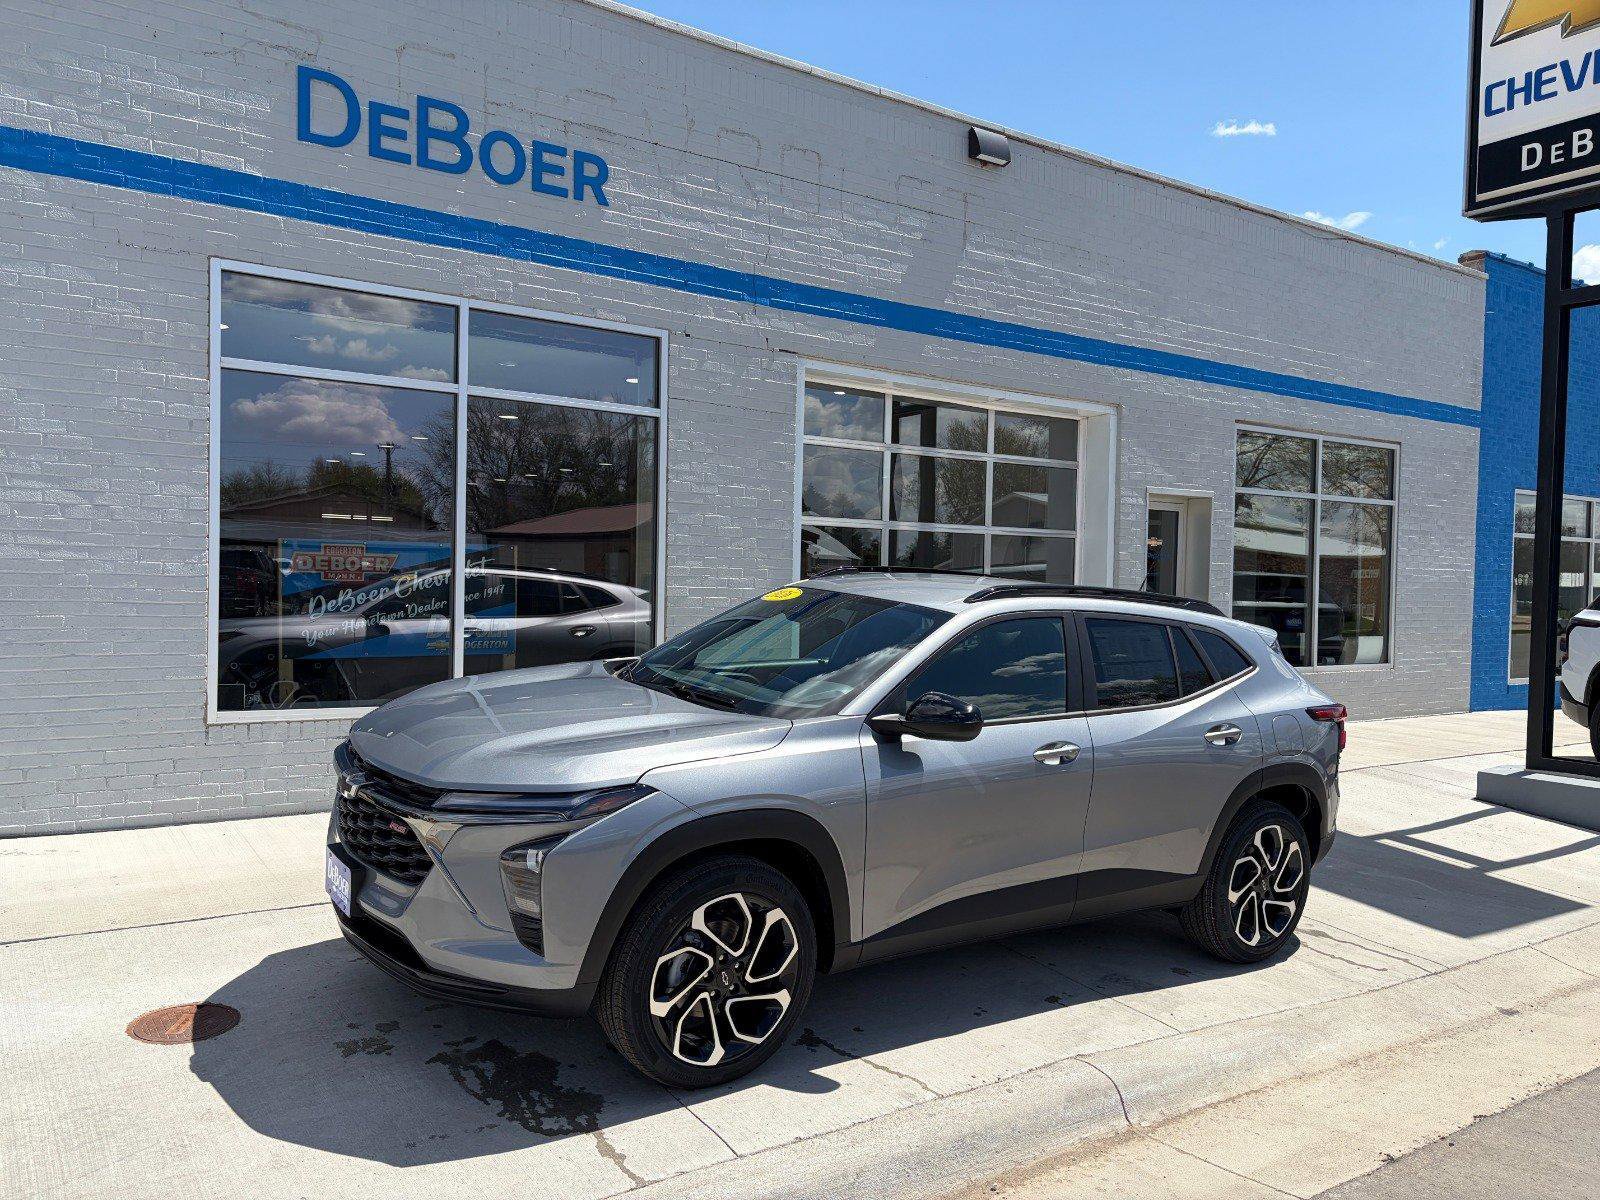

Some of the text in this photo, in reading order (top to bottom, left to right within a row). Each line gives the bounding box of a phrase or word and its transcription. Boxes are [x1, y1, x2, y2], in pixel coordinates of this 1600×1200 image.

[326, 546, 362, 555] EDGERTON
[296, 555, 389, 572] DEBOER
[308, 556, 495, 624] DeBoer Chevrlet
[302, 627, 338, 647] Your
[342, 611, 404, 635] Hometown
[407, 598, 448, 618] Dealer
[464, 640, 509, 650] DGERTON
